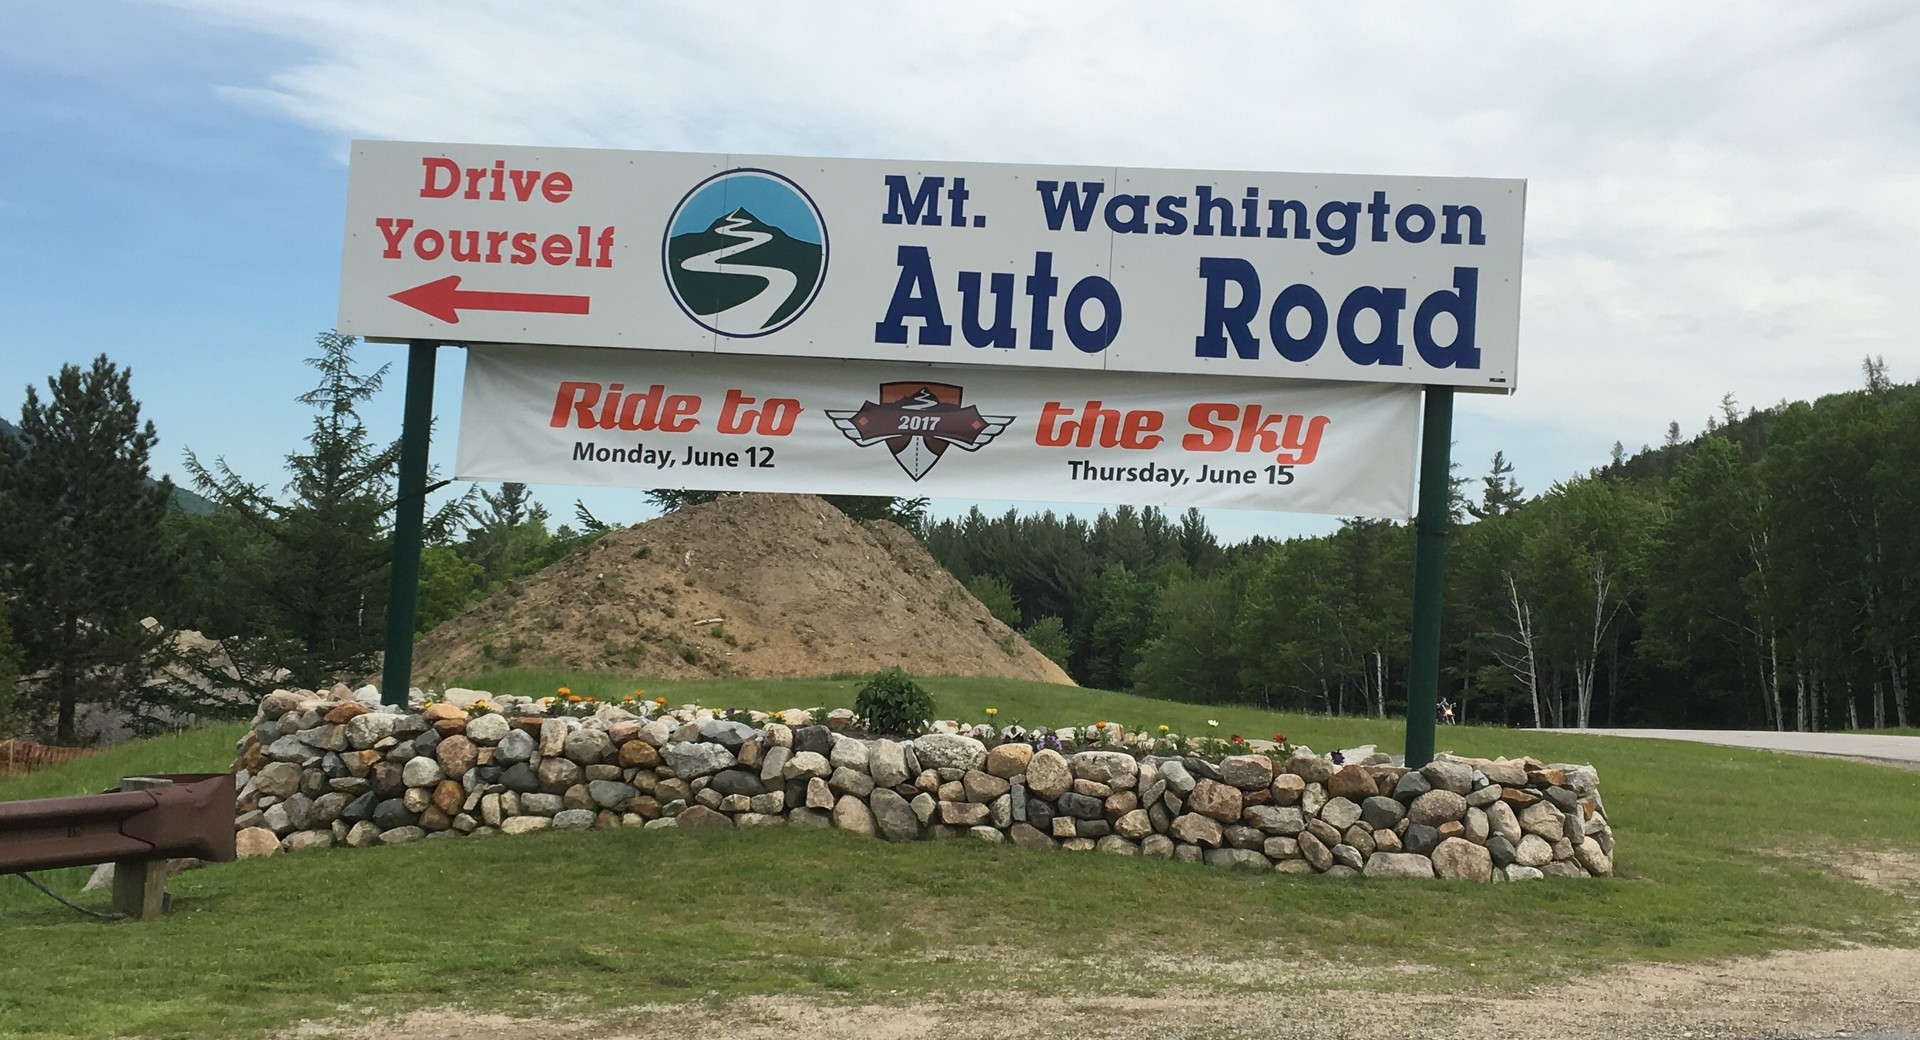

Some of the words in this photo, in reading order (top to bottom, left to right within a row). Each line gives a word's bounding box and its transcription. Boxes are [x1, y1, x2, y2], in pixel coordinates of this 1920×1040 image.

[419, 156, 574, 204] Drive
[881, 174, 987, 229] Mt.
[1036, 179, 1487, 256] Washington
[375, 217, 616, 269] Yourself
[874, 244, 1124, 354] Auto
[1194, 256, 1482, 371] Road
[549, 380, 702, 434] Ride
[716, 388, 805, 437] to
[897, 415, 941, 431] 2017
[1034, 400, 1165, 450] the
[1182, 402, 1331, 466] Sky
[572, 441, 676, 470] Monday,
[682, 445, 739, 469] June
[745, 446, 776, 469] 12
[1067, 460, 1190, 487] Thursday,
[1195, 464, 1258, 487] June
[1263, 464, 1295, 486] 15
